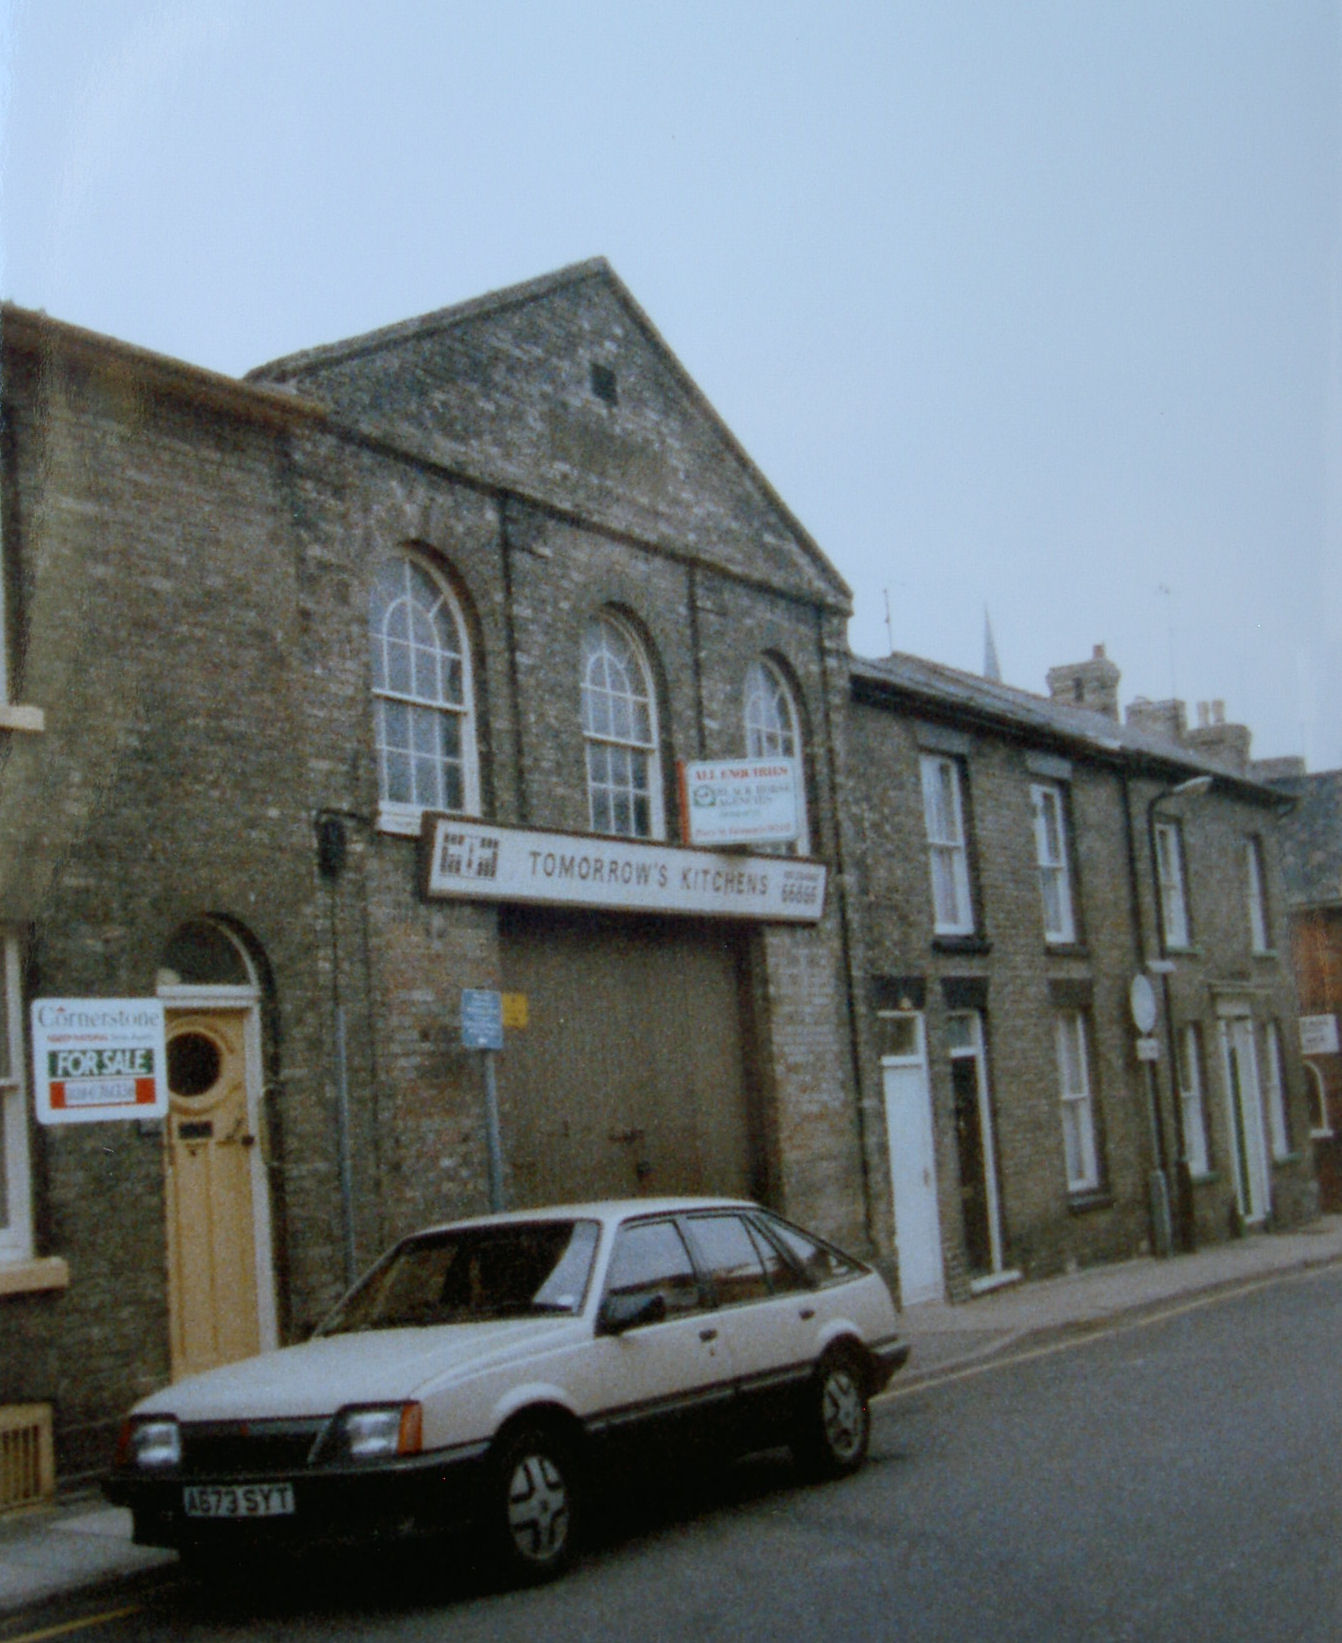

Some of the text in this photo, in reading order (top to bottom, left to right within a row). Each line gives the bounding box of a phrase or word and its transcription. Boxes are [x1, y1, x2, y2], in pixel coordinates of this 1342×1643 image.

[696, 770, 716, 781] ALL
[531, 852, 769, 898] TOMORROW'S KITCHENS
[38, 1006, 158, 1027] Cornerstone
[57, 1049, 146, 1076] FOR SALE
[243, 1487, 289, 1512] SYT
